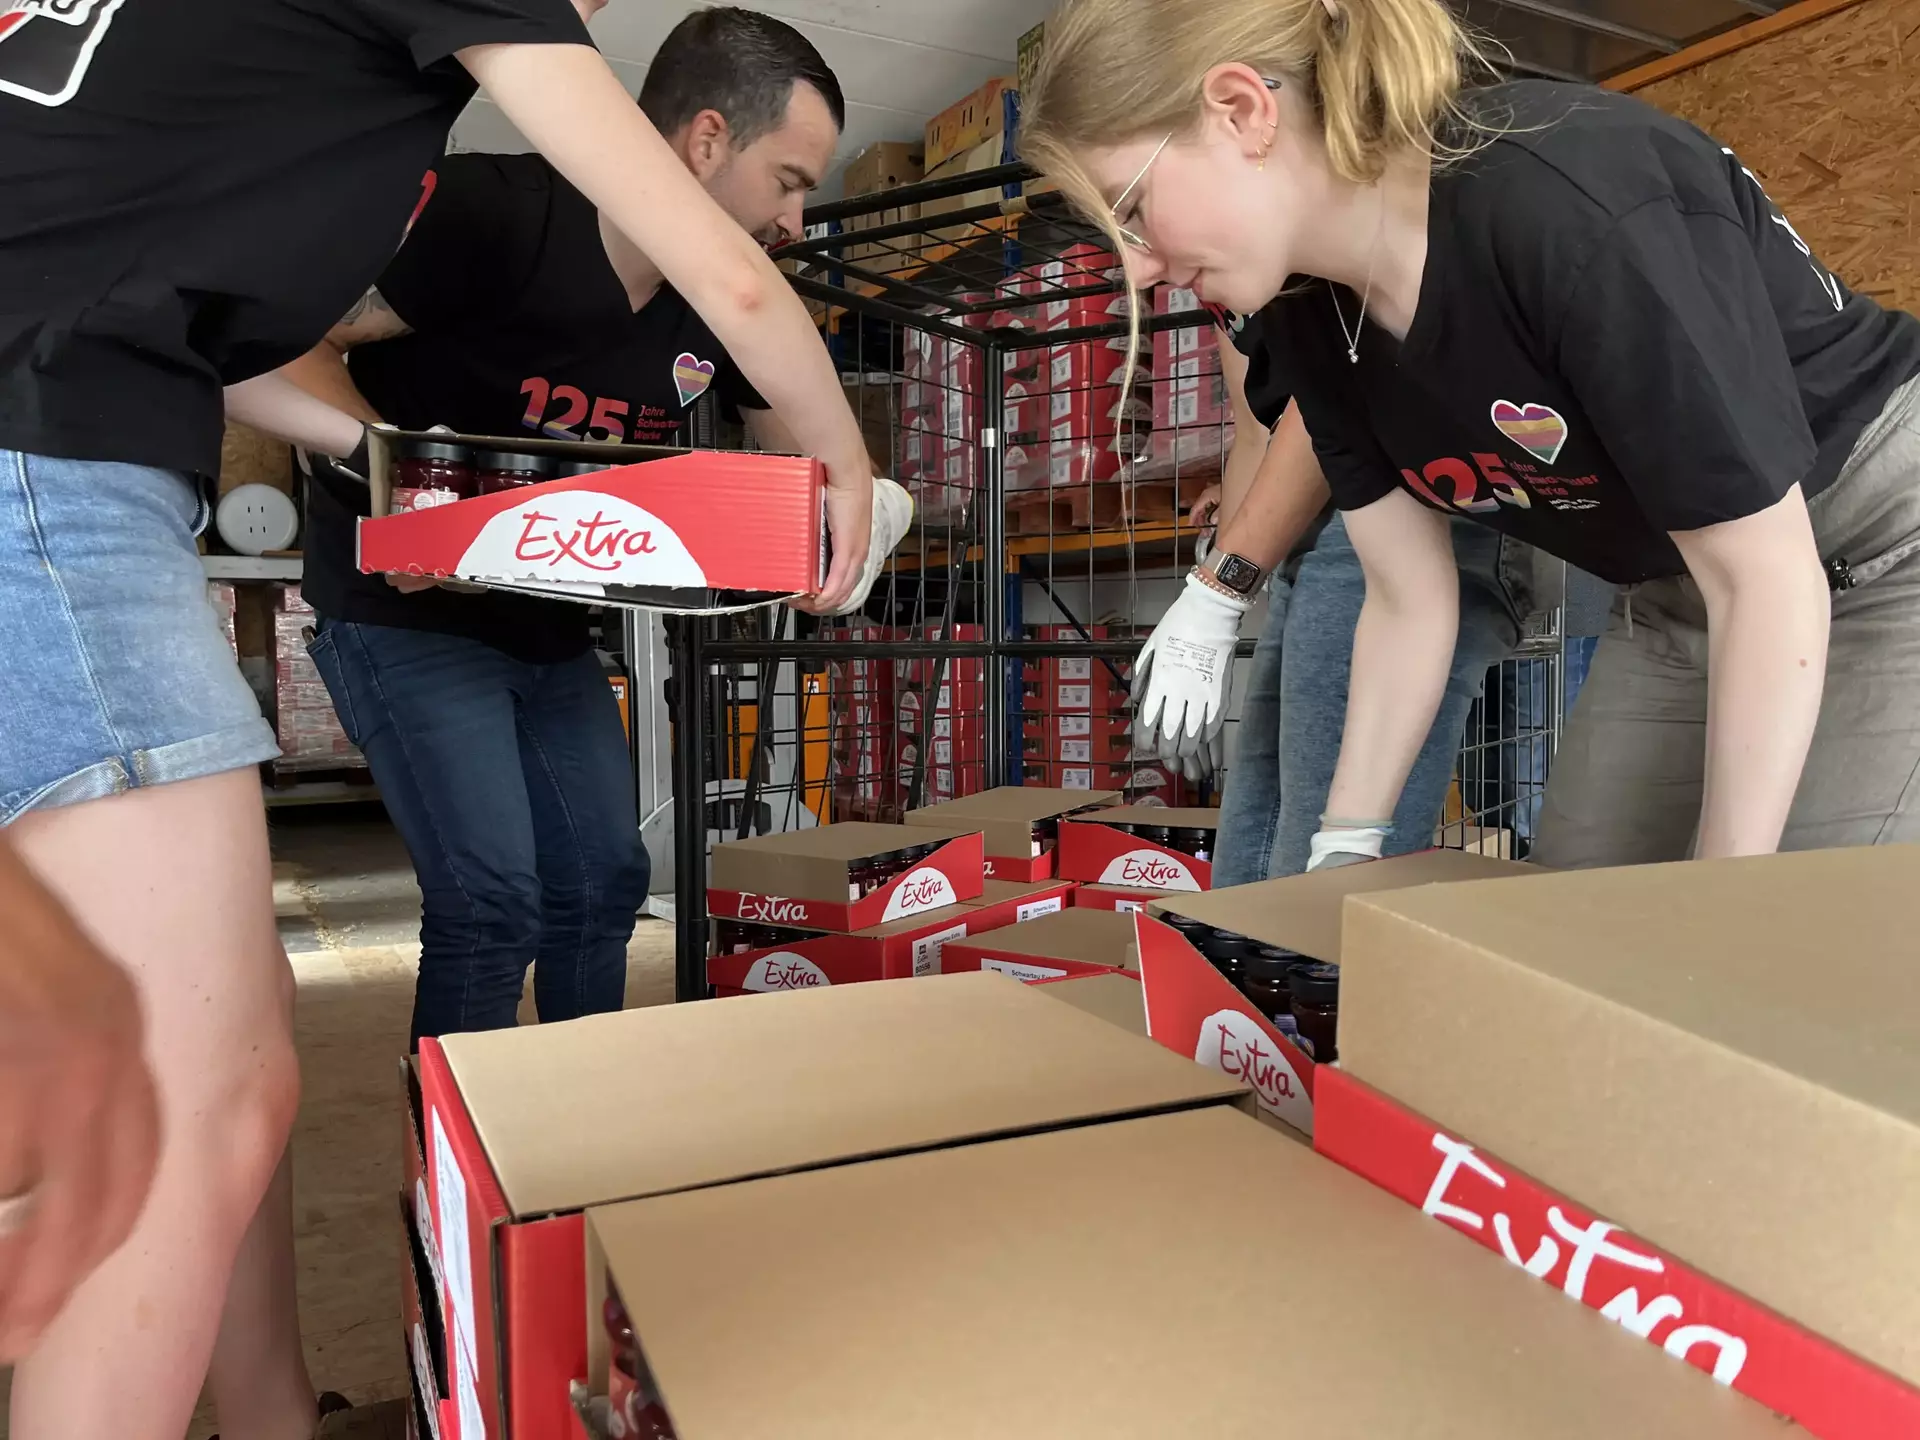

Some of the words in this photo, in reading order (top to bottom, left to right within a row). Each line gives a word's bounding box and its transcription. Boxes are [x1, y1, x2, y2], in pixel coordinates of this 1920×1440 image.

[520, 376, 629, 444] 125
[638, 405, 666, 418] Jahre
[515, 511, 657, 571] Extra
[1122, 857, 1181, 886] Extra
[737, 891, 809, 922] Extra
[900, 875, 944, 909] Extra
[764, 960, 820, 990] Extra
[1217, 1023, 1296, 1107] Extra
